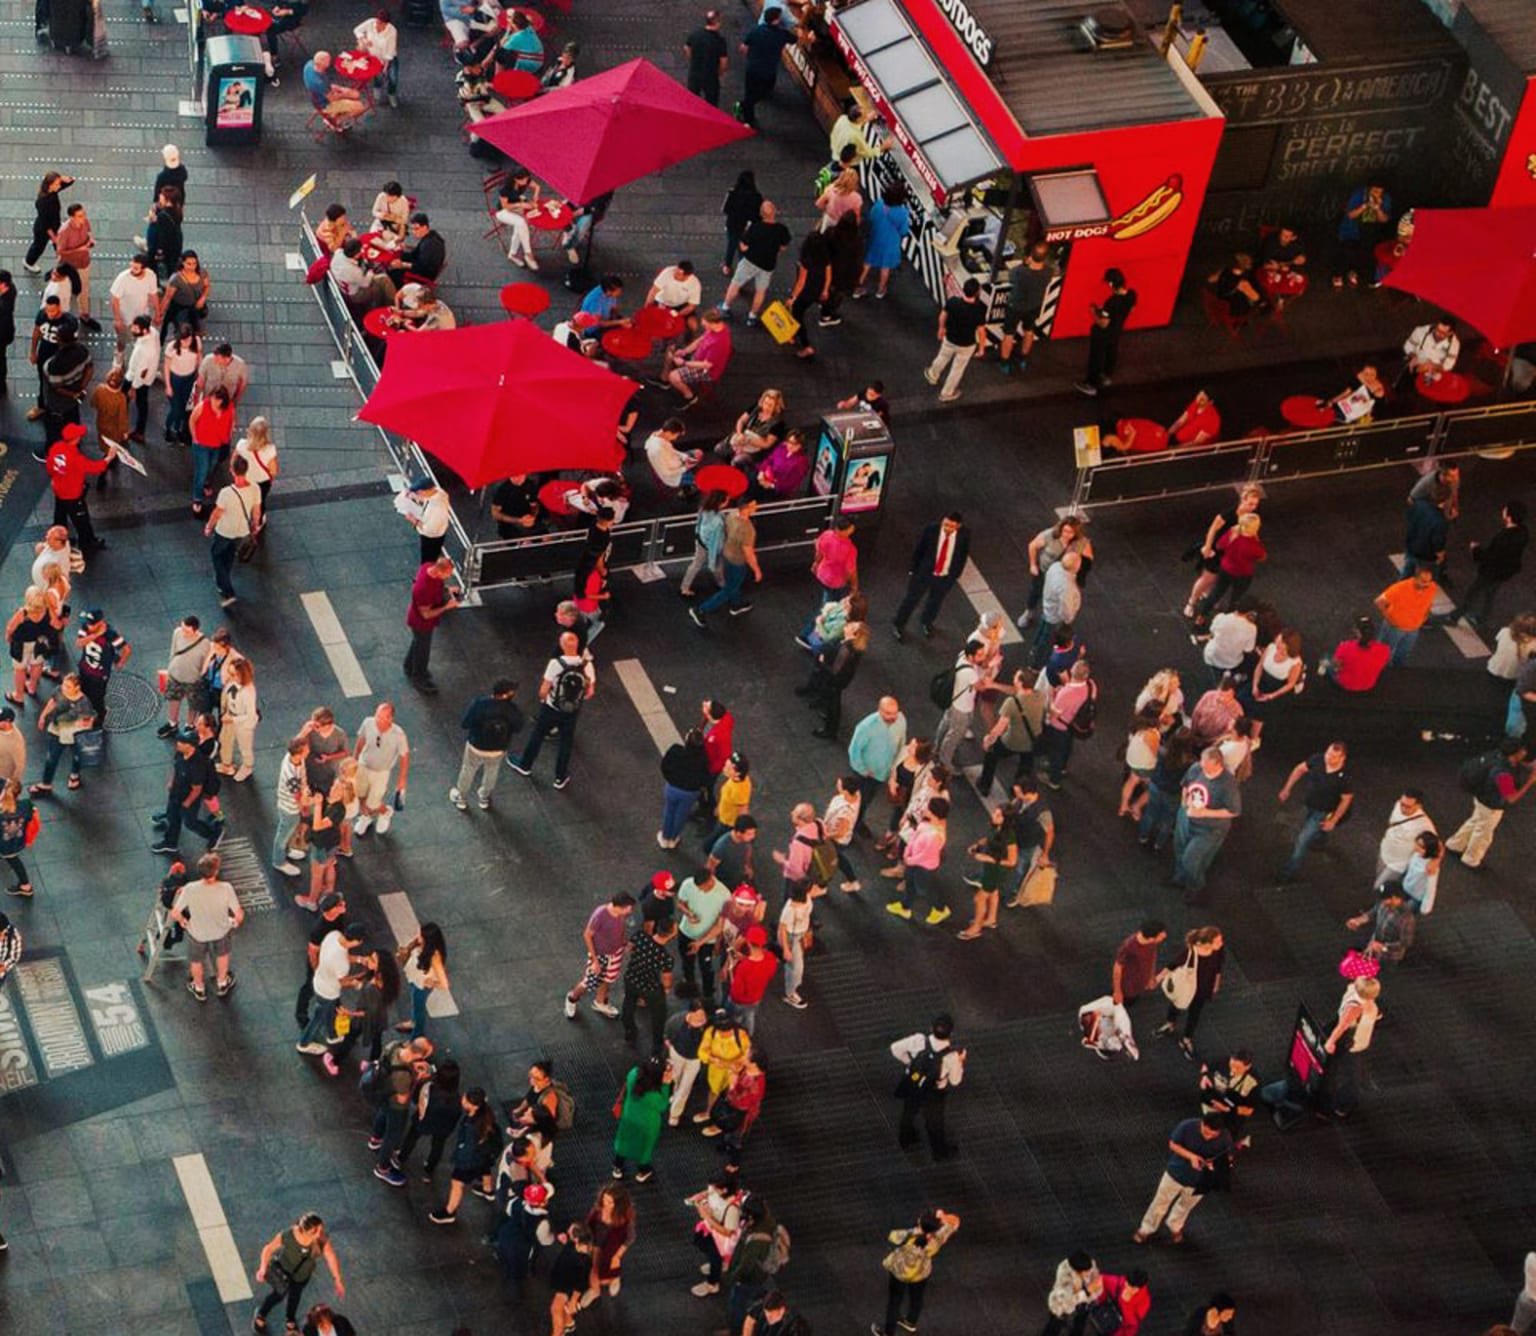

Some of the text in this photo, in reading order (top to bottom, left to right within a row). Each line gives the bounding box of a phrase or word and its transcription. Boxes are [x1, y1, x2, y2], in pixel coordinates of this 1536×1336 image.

[1355, 71, 1441, 99] AMERICA
[1463, 68, 1512, 141] BEST
[1284, 127, 1425, 161] PERFECT
[1278, 157, 1337, 180] STREET
[1046, 226, 1108, 242] HOT DOGS
[85, 983, 138, 1026] 54
